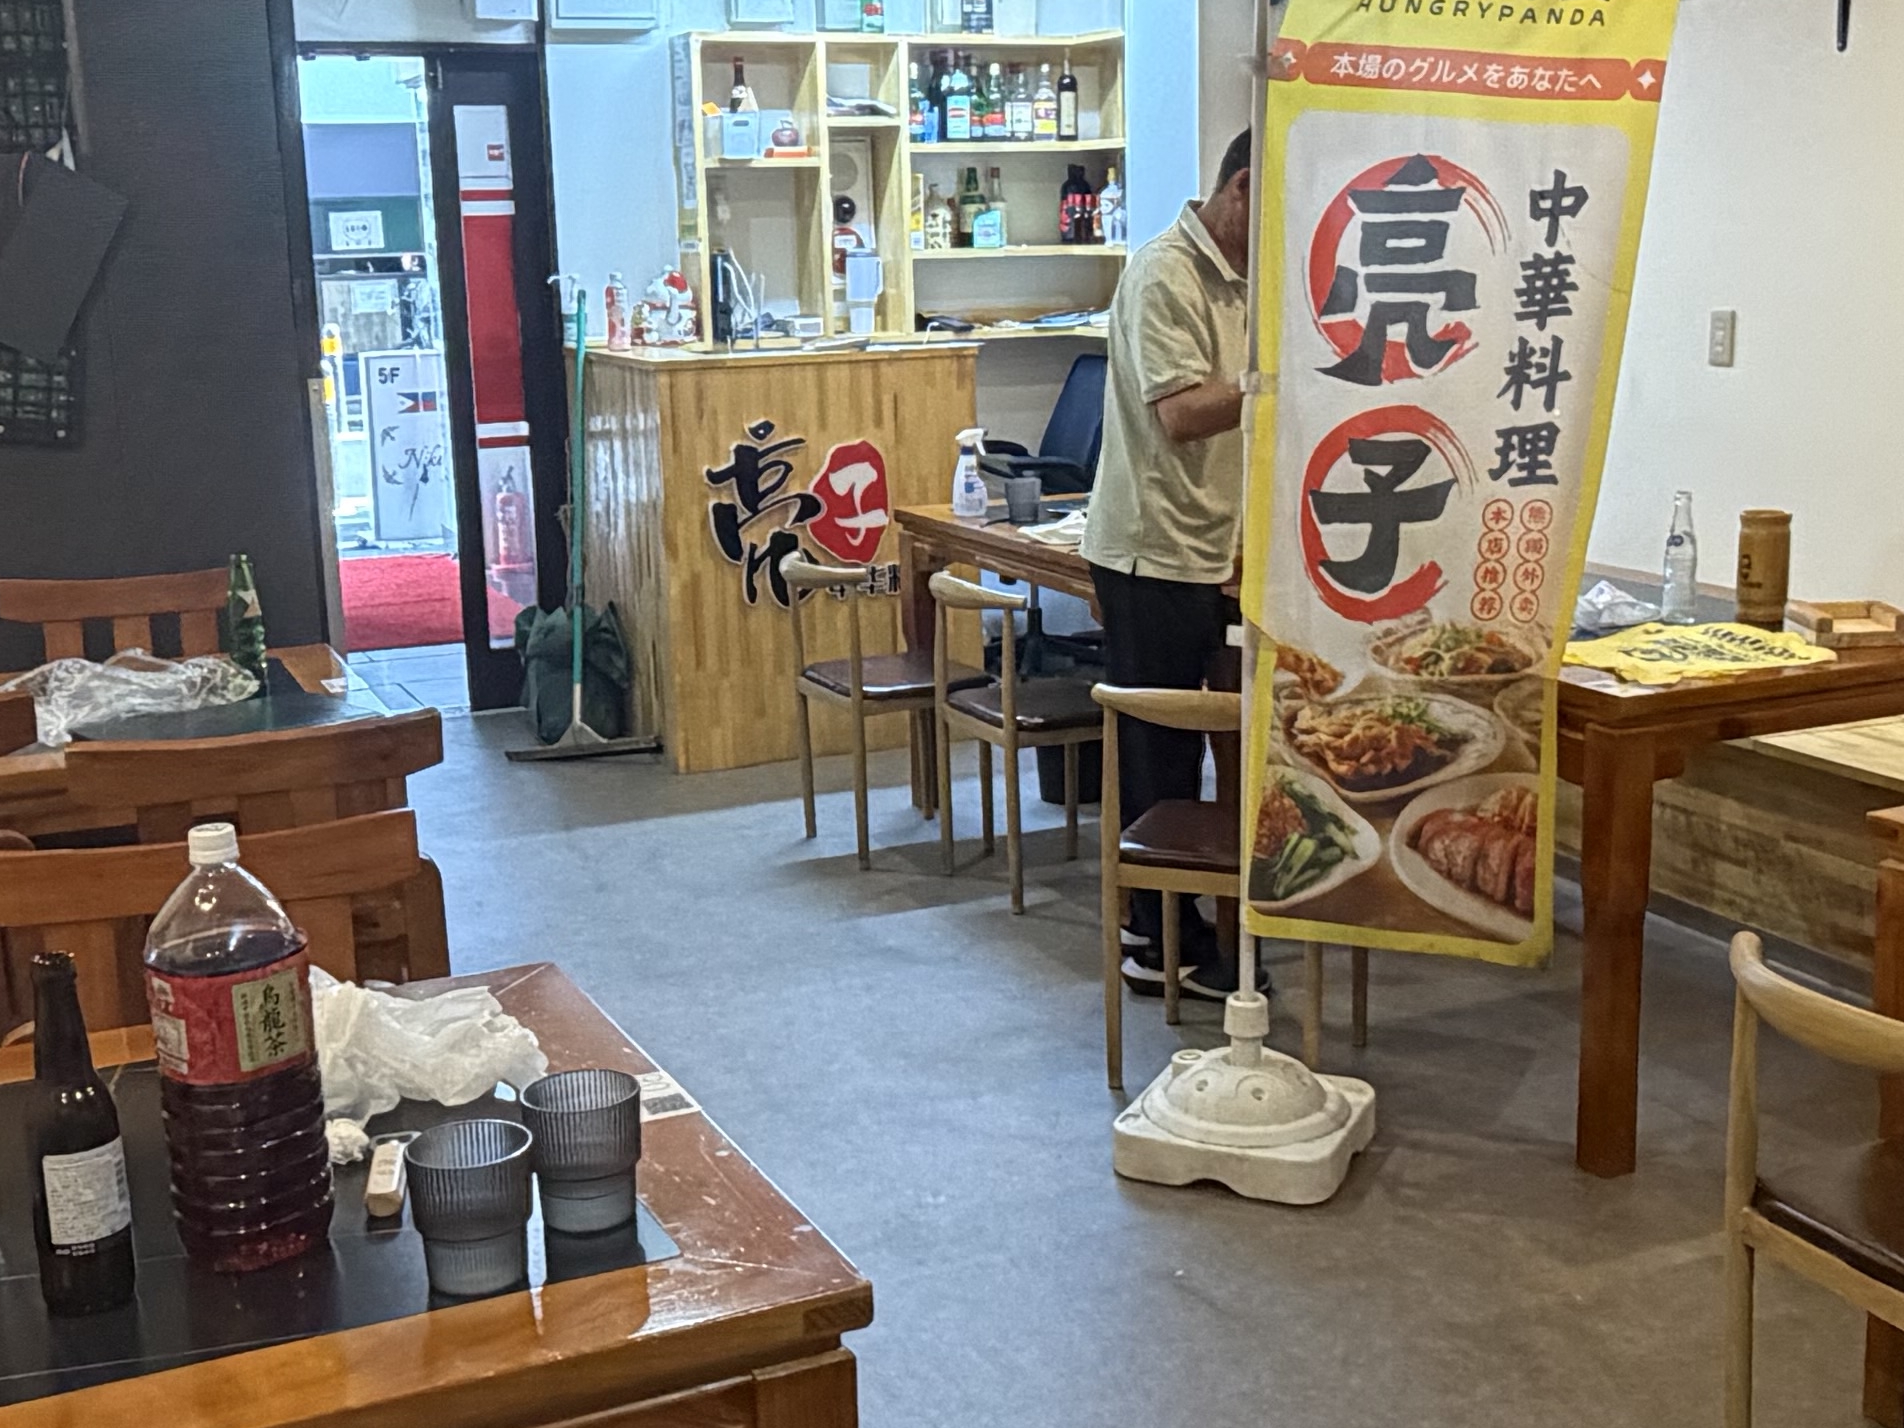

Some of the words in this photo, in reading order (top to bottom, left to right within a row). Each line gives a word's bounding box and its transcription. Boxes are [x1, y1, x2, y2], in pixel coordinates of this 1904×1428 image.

[1329, 51, 1602, 94] 本場のグルメをあなたへ
[378, 367, 400, 384] 5F
[1309, 153, 1480, 597] 亮子
[1488, 168, 1591, 489] 中華料理
